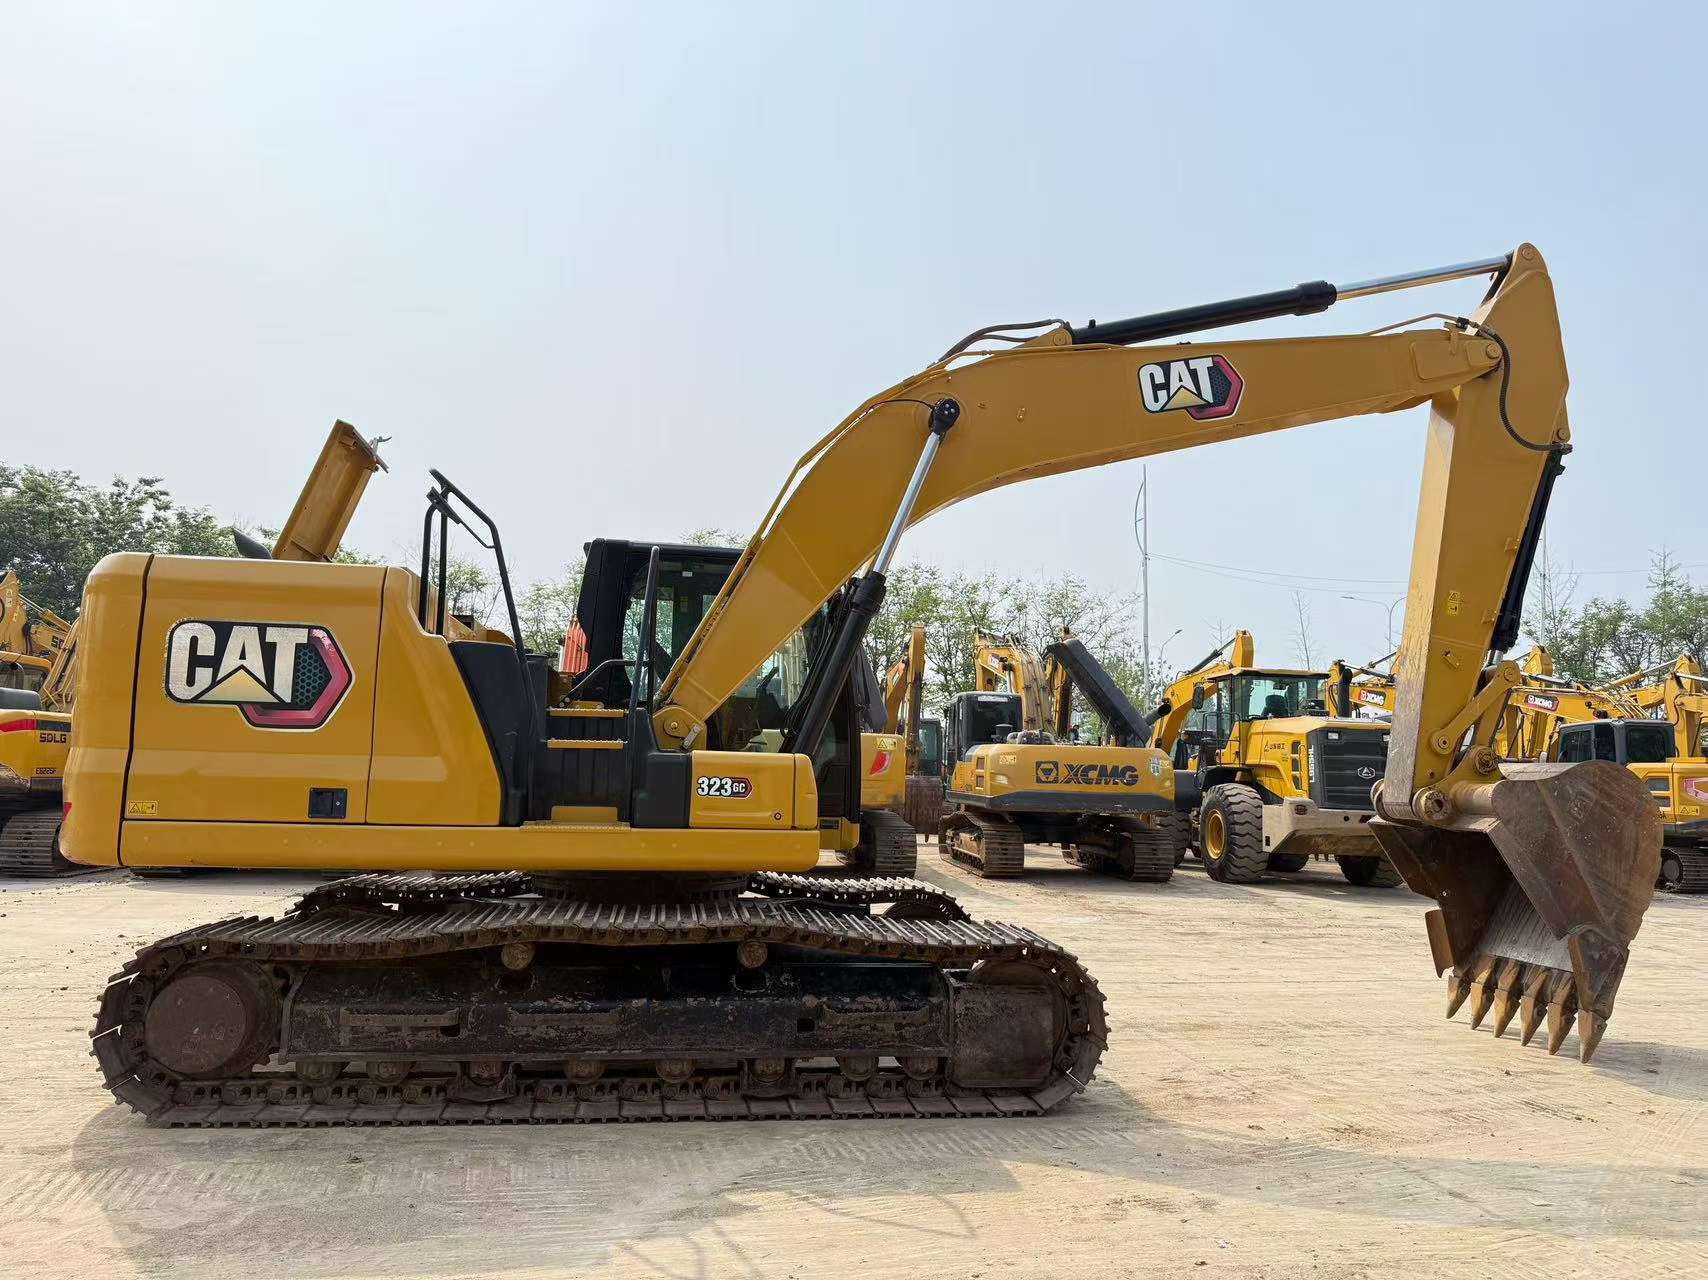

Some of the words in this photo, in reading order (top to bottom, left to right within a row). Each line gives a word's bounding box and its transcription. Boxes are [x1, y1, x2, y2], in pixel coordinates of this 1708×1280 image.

[1139, 357, 1214, 412] CAT
[169, 622, 309, 703] CAT
[40, 733, 67, 743] SDLG
[1059, 763, 1139, 786] XCMG
[697, 776, 732, 797] 323
[732, 783, 746, 793] GC
